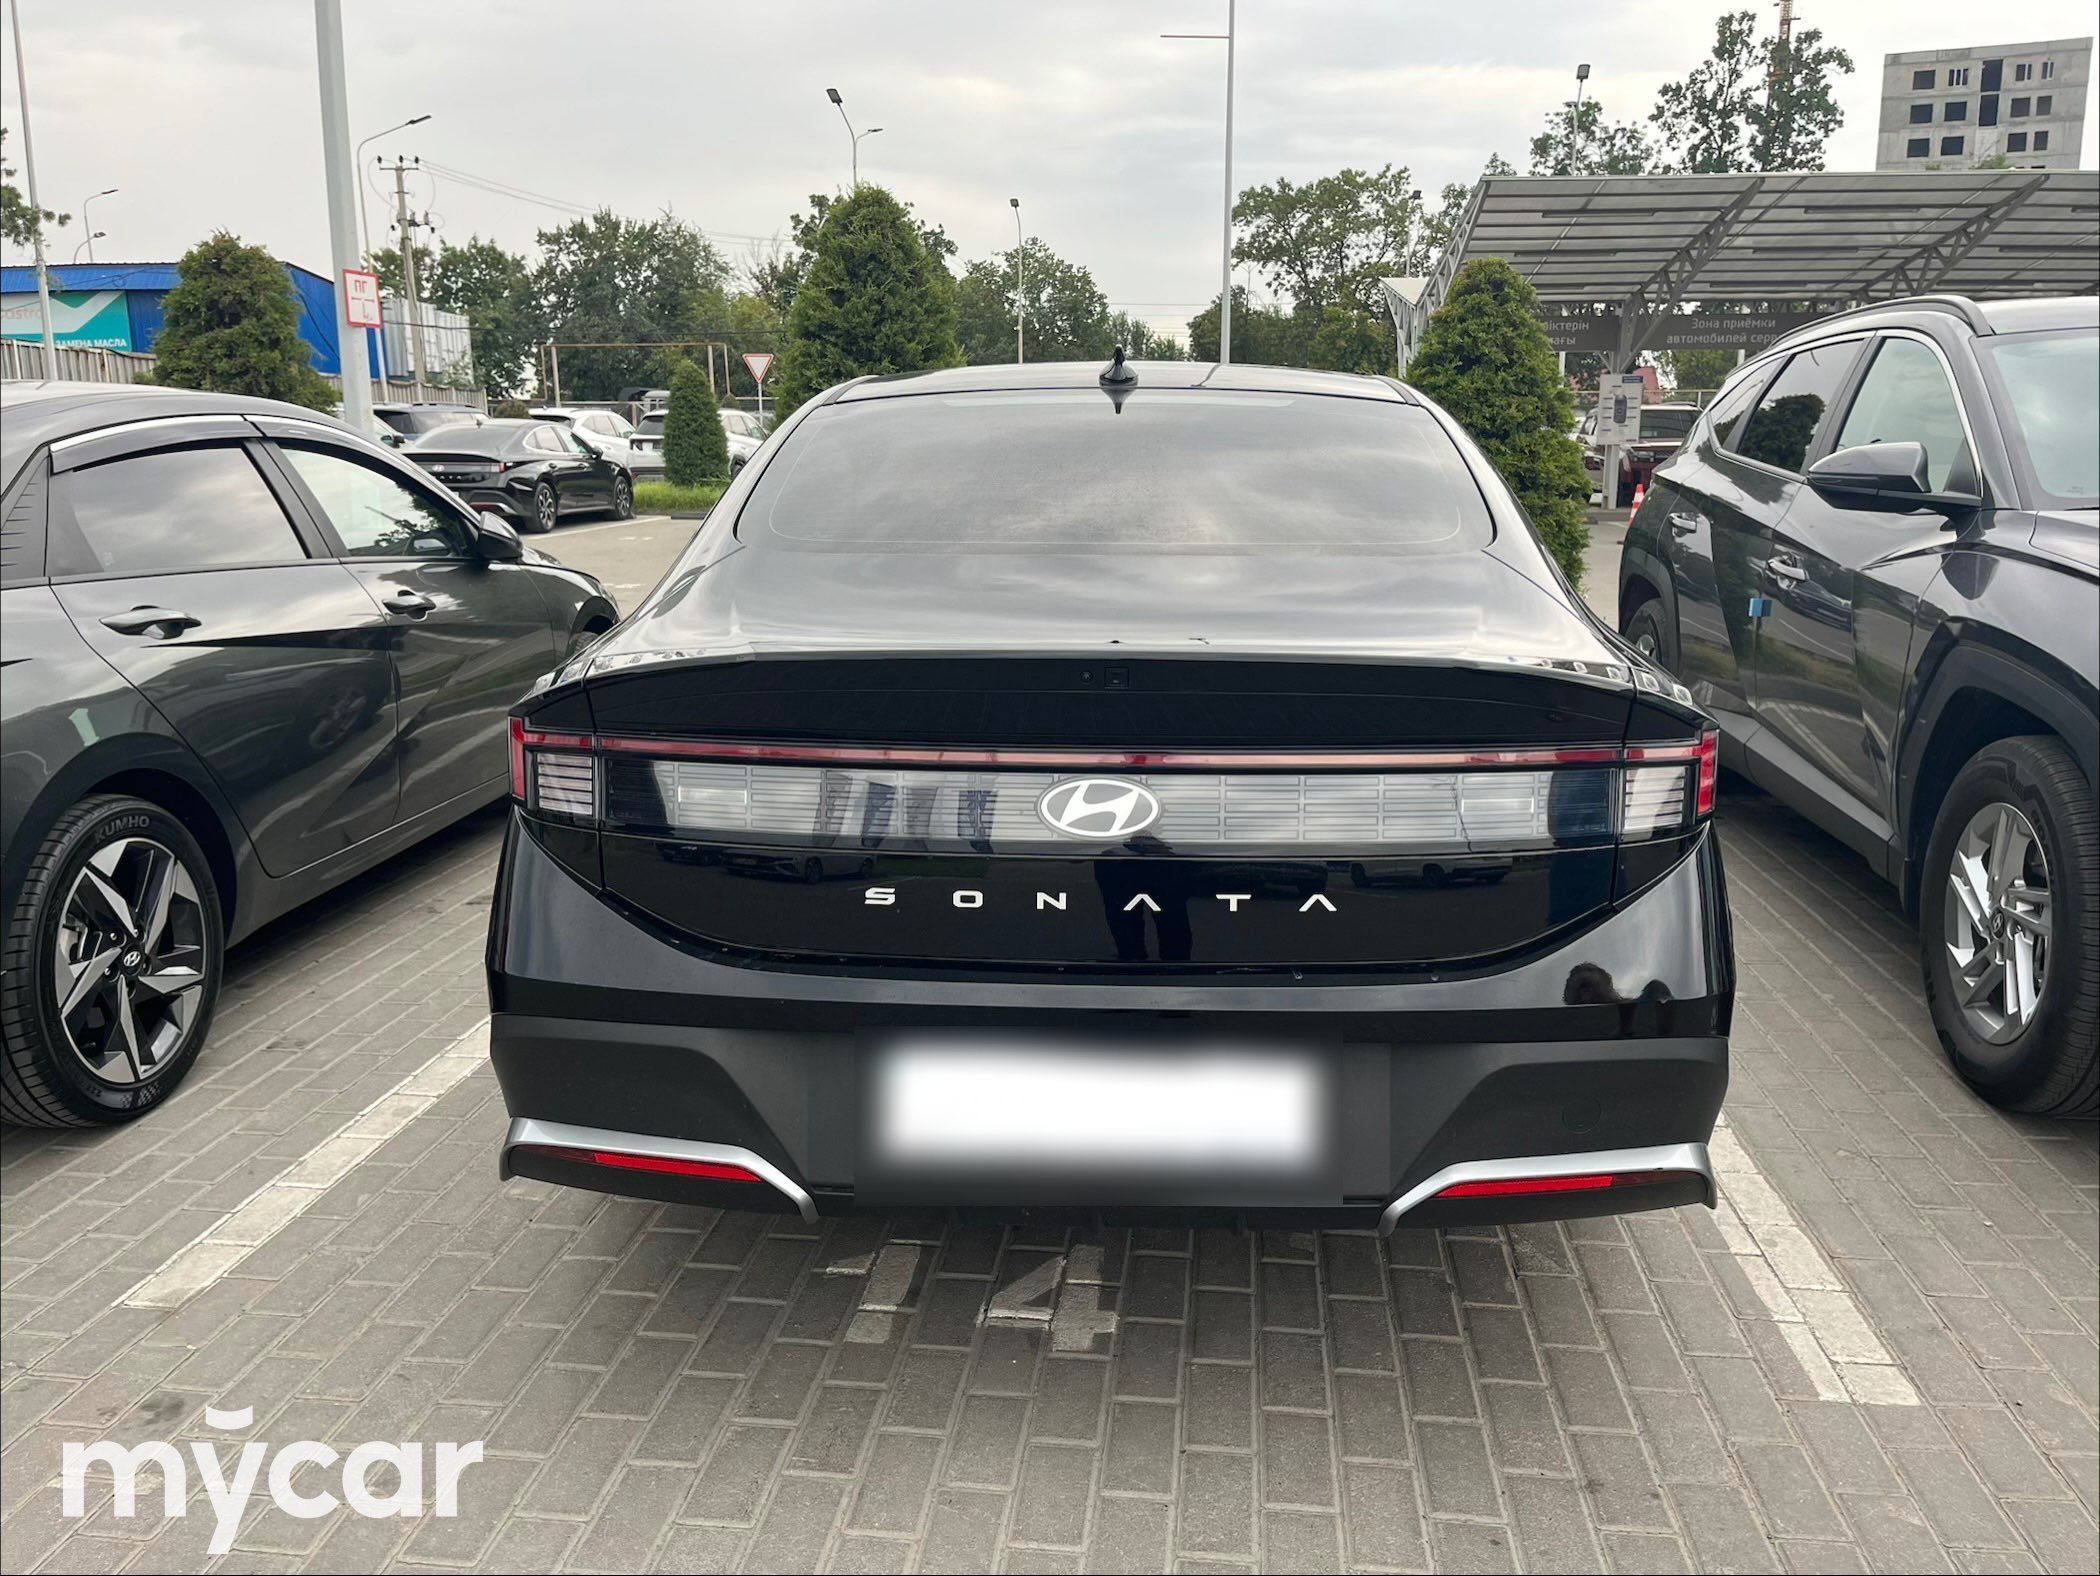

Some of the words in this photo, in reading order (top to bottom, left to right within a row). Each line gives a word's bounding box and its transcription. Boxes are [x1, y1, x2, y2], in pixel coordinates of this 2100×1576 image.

[355, 279, 368, 293] ПГ
[1691, 318, 1720, 329] Зона
[1723, 317, 1776, 330] приёмки
[94, 338, 127, 347] МАСЛА
[1666, 333, 1748, 344] автомобилей
[95, 815, 150, 844] KUMHO
[865, 887, 1337, 912] SONATA
